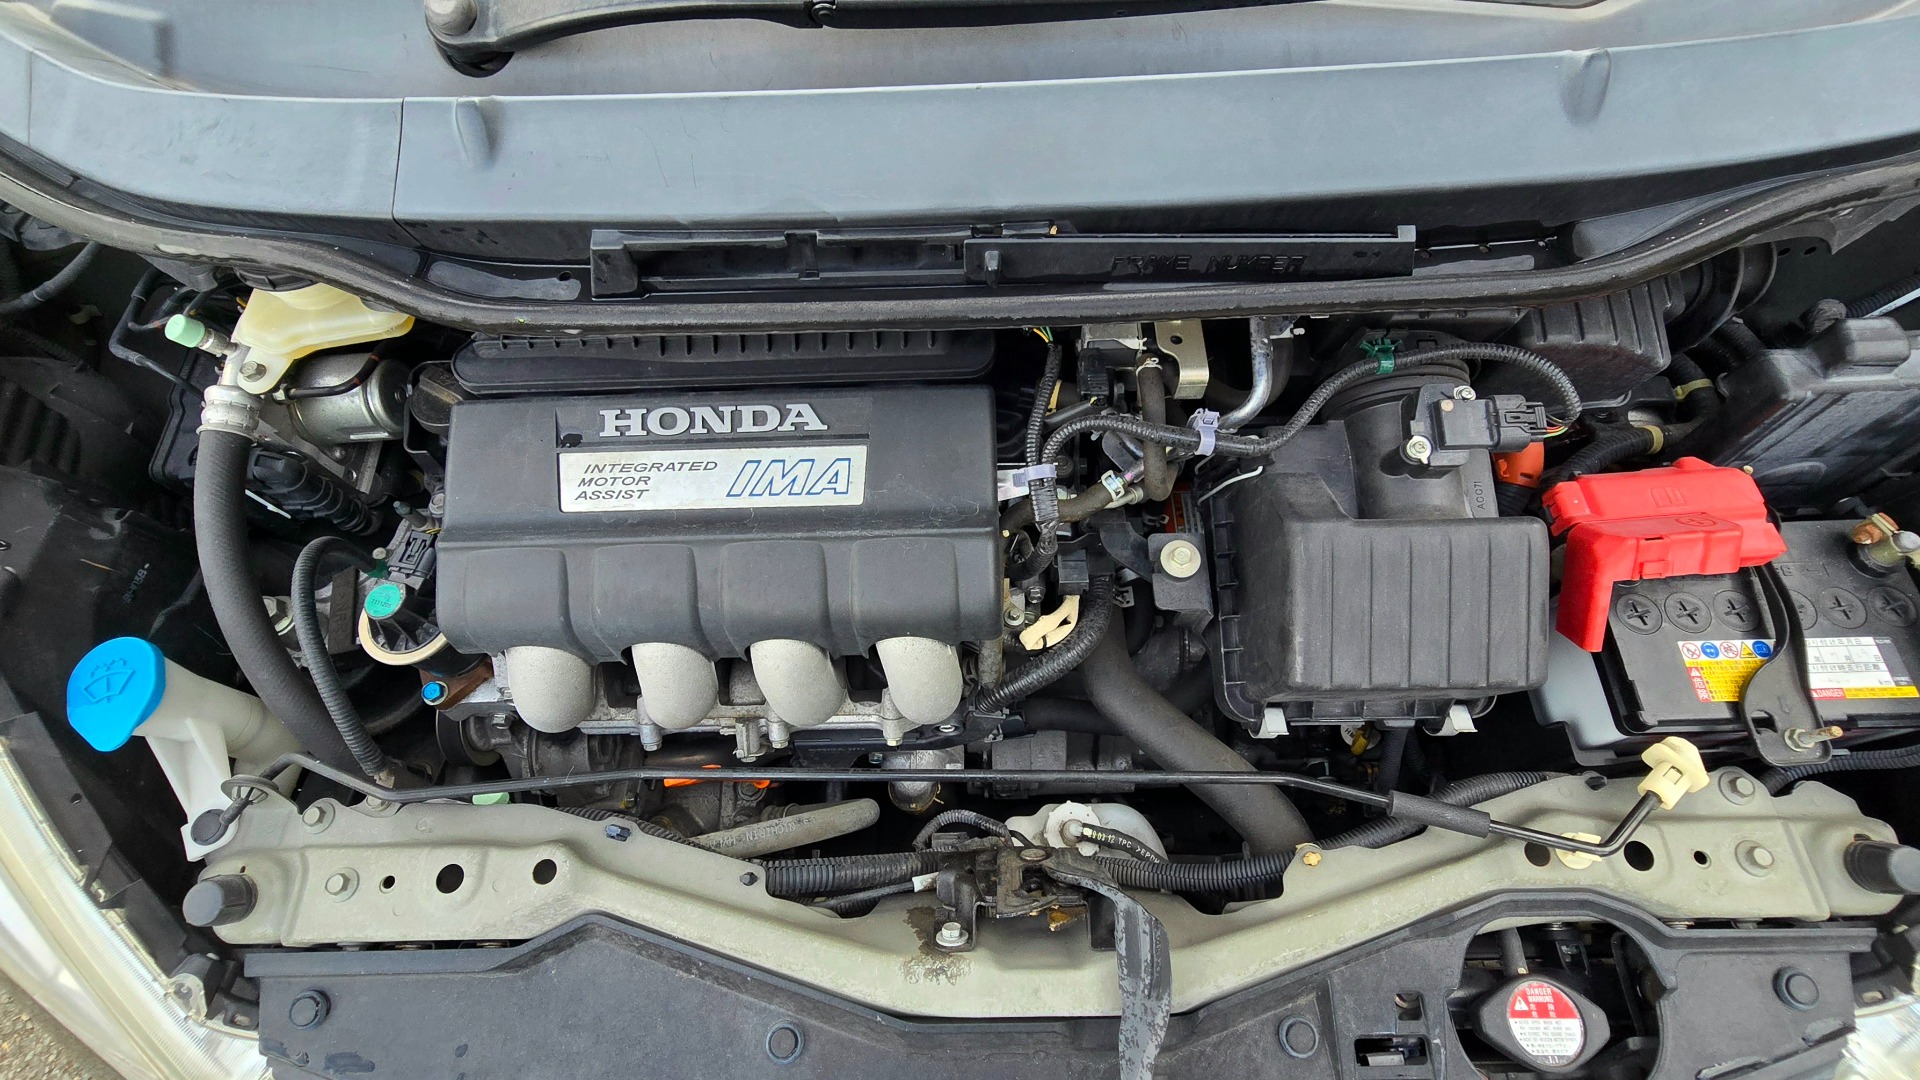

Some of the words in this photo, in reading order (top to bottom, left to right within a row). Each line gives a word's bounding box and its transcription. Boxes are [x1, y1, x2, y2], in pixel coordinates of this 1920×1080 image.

[599, 403, 828, 438] HONDA
[583, 460, 719, 474] INTEGRATED
[577, 475, 652, 488] MOTOR
[726, 457, 852, 498] IMA
[574, 489, 650, 502] ASSIST
